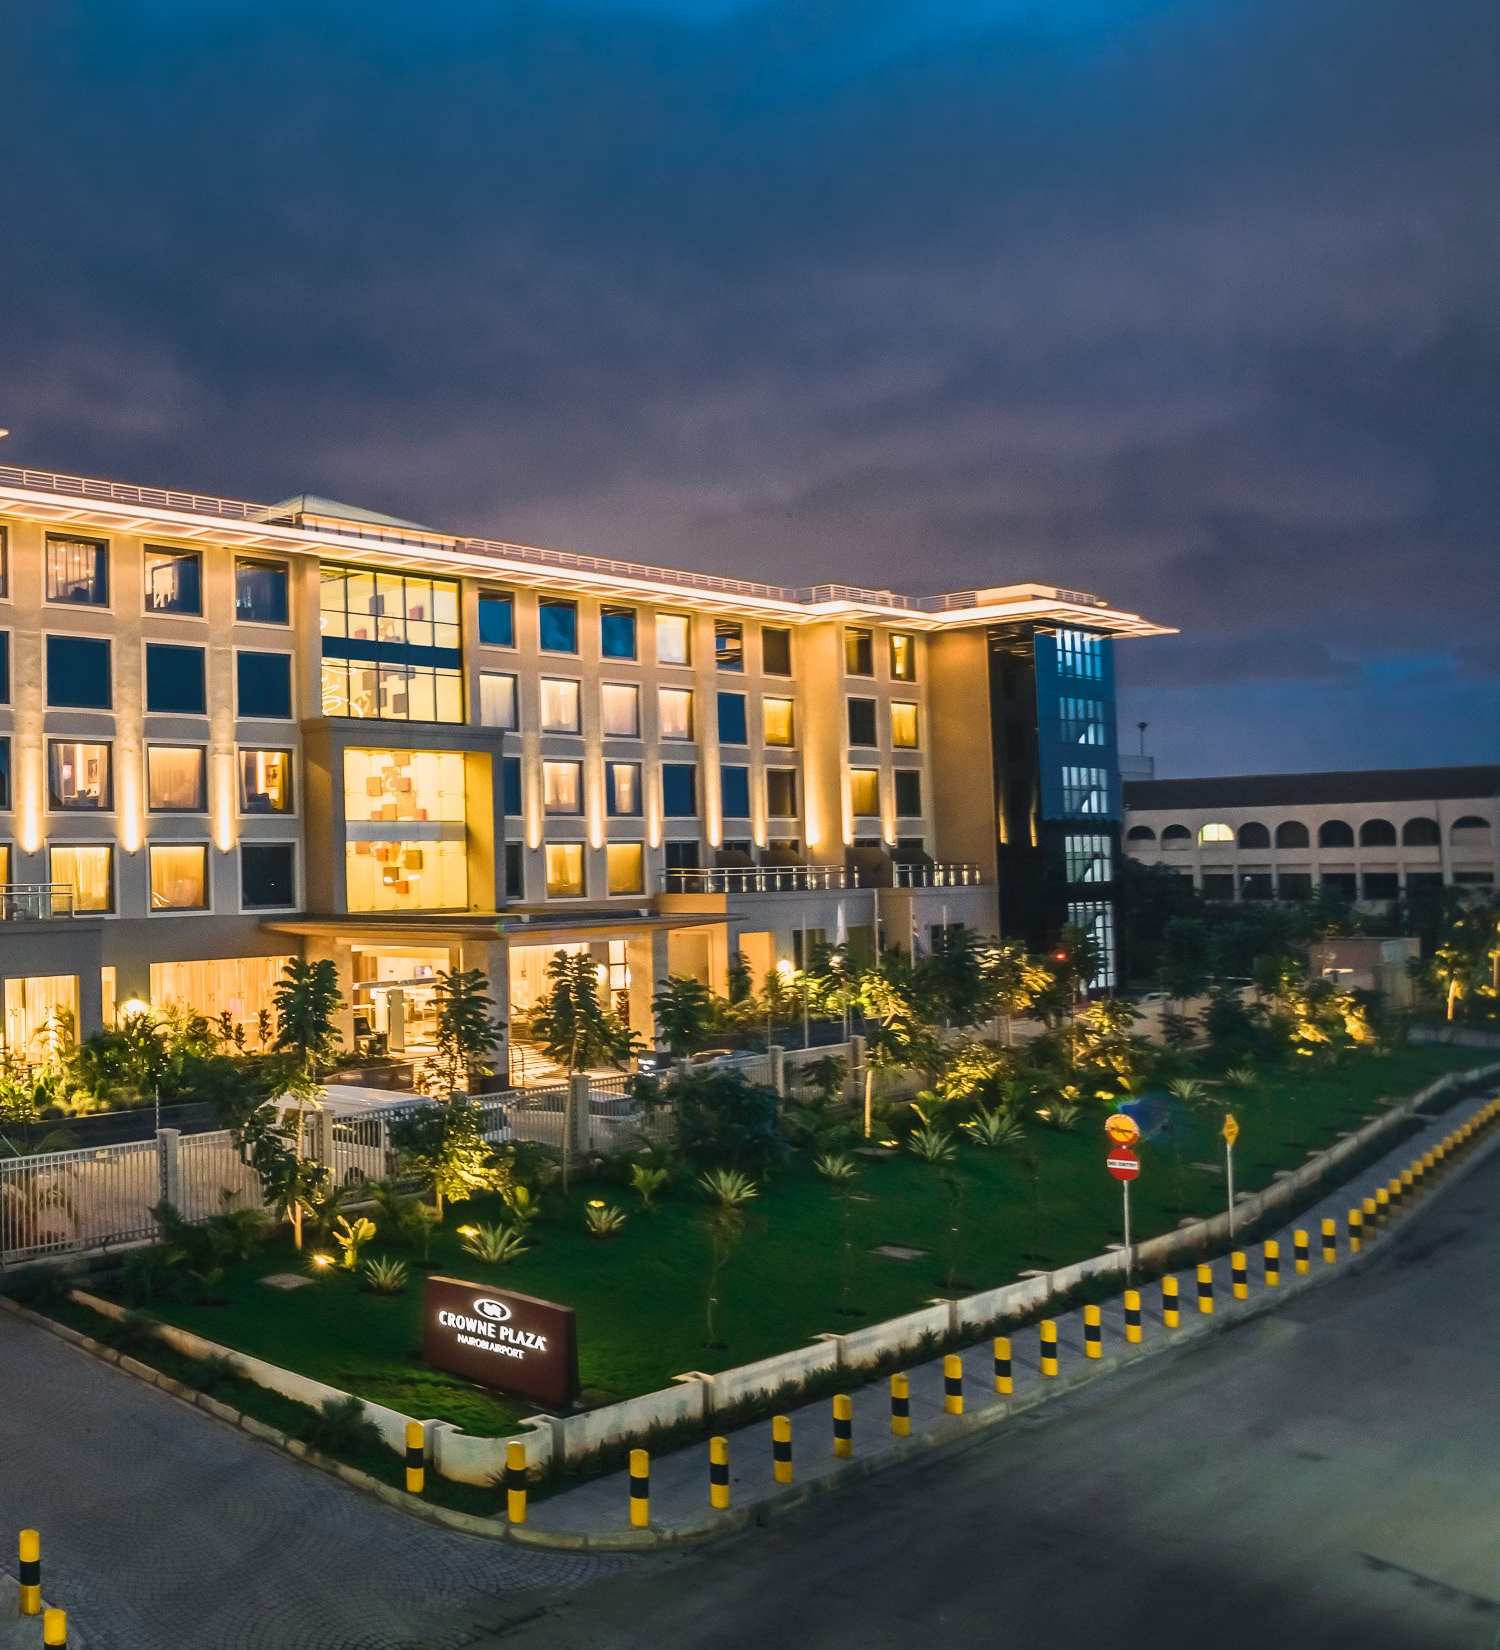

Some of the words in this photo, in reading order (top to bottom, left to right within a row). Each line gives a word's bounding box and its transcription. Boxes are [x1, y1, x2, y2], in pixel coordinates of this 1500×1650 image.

[438, 1310, 497, 1338] CROWNE
[457, 1333, 489, 1350] NAIROBI
[489, 1342, 525, 1359] AIRPORT
